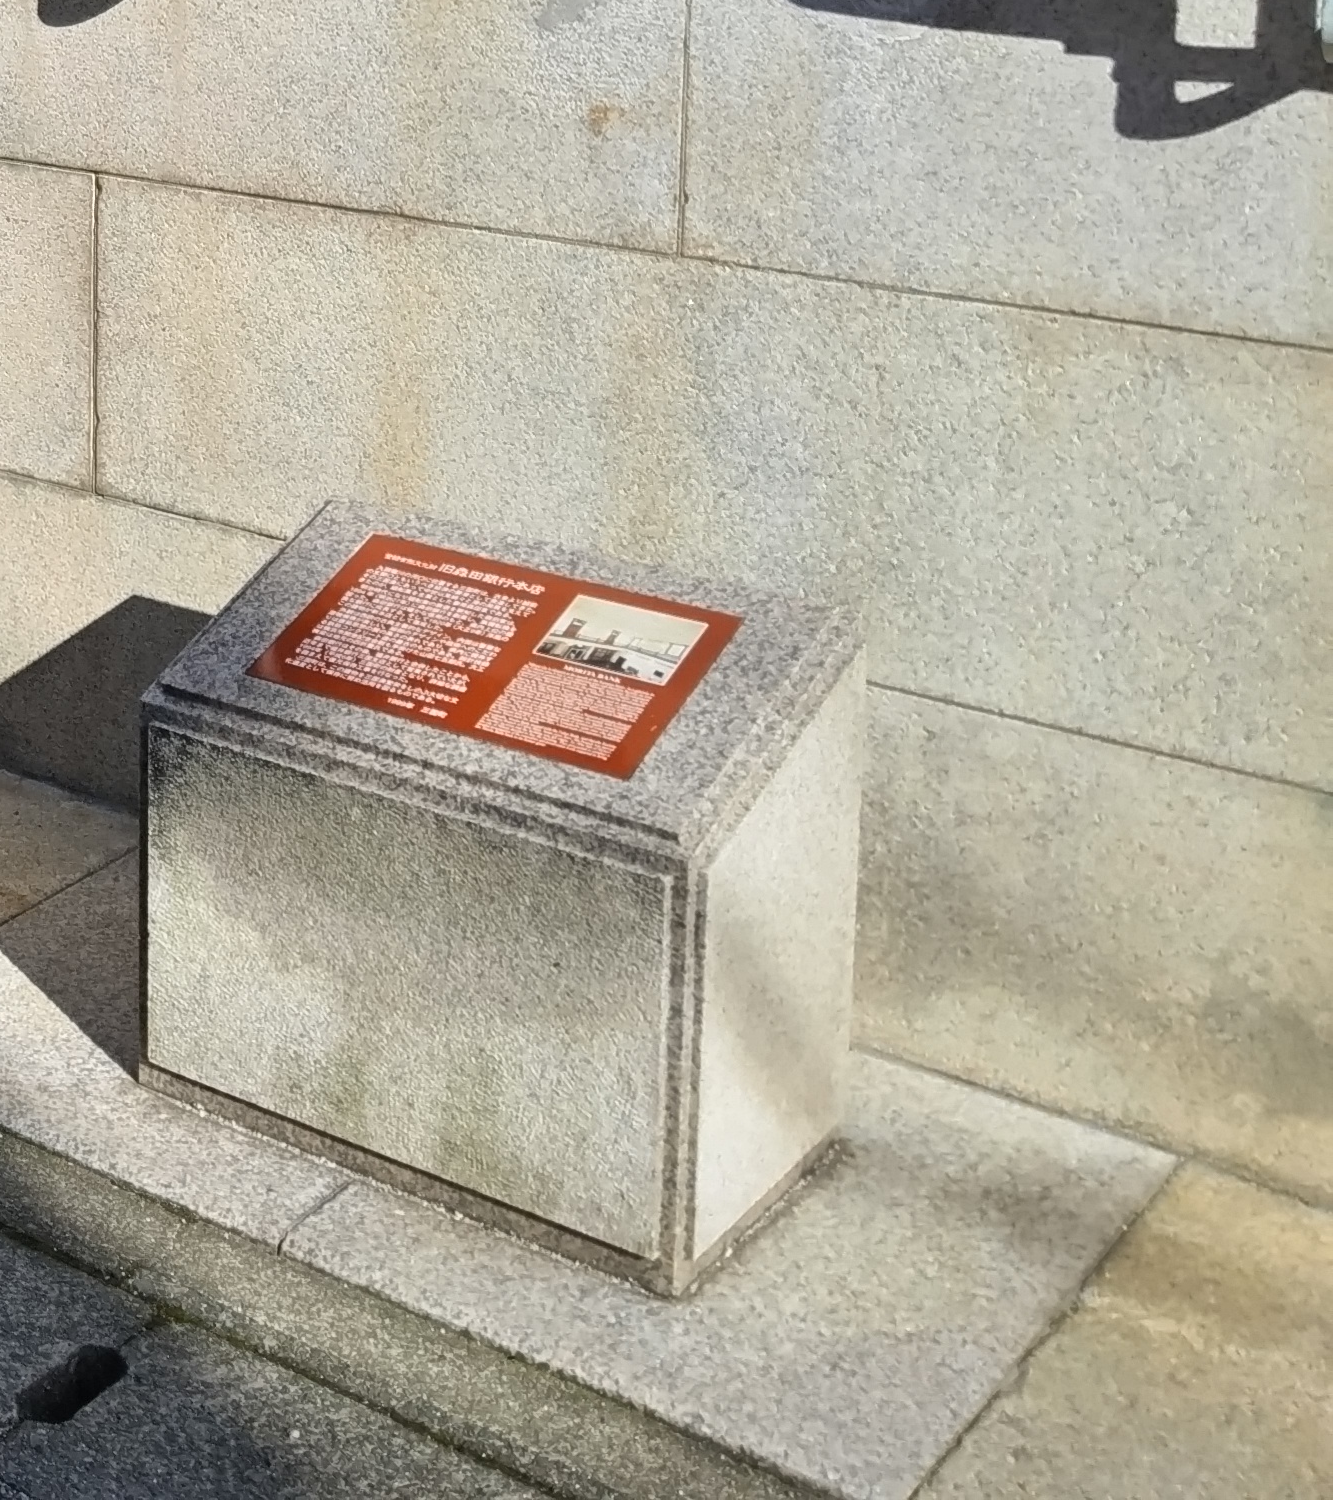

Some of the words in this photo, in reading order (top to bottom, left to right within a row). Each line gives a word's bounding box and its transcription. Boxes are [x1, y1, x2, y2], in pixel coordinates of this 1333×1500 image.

[439, 562, 546, 596] 旧森田銀行本店
